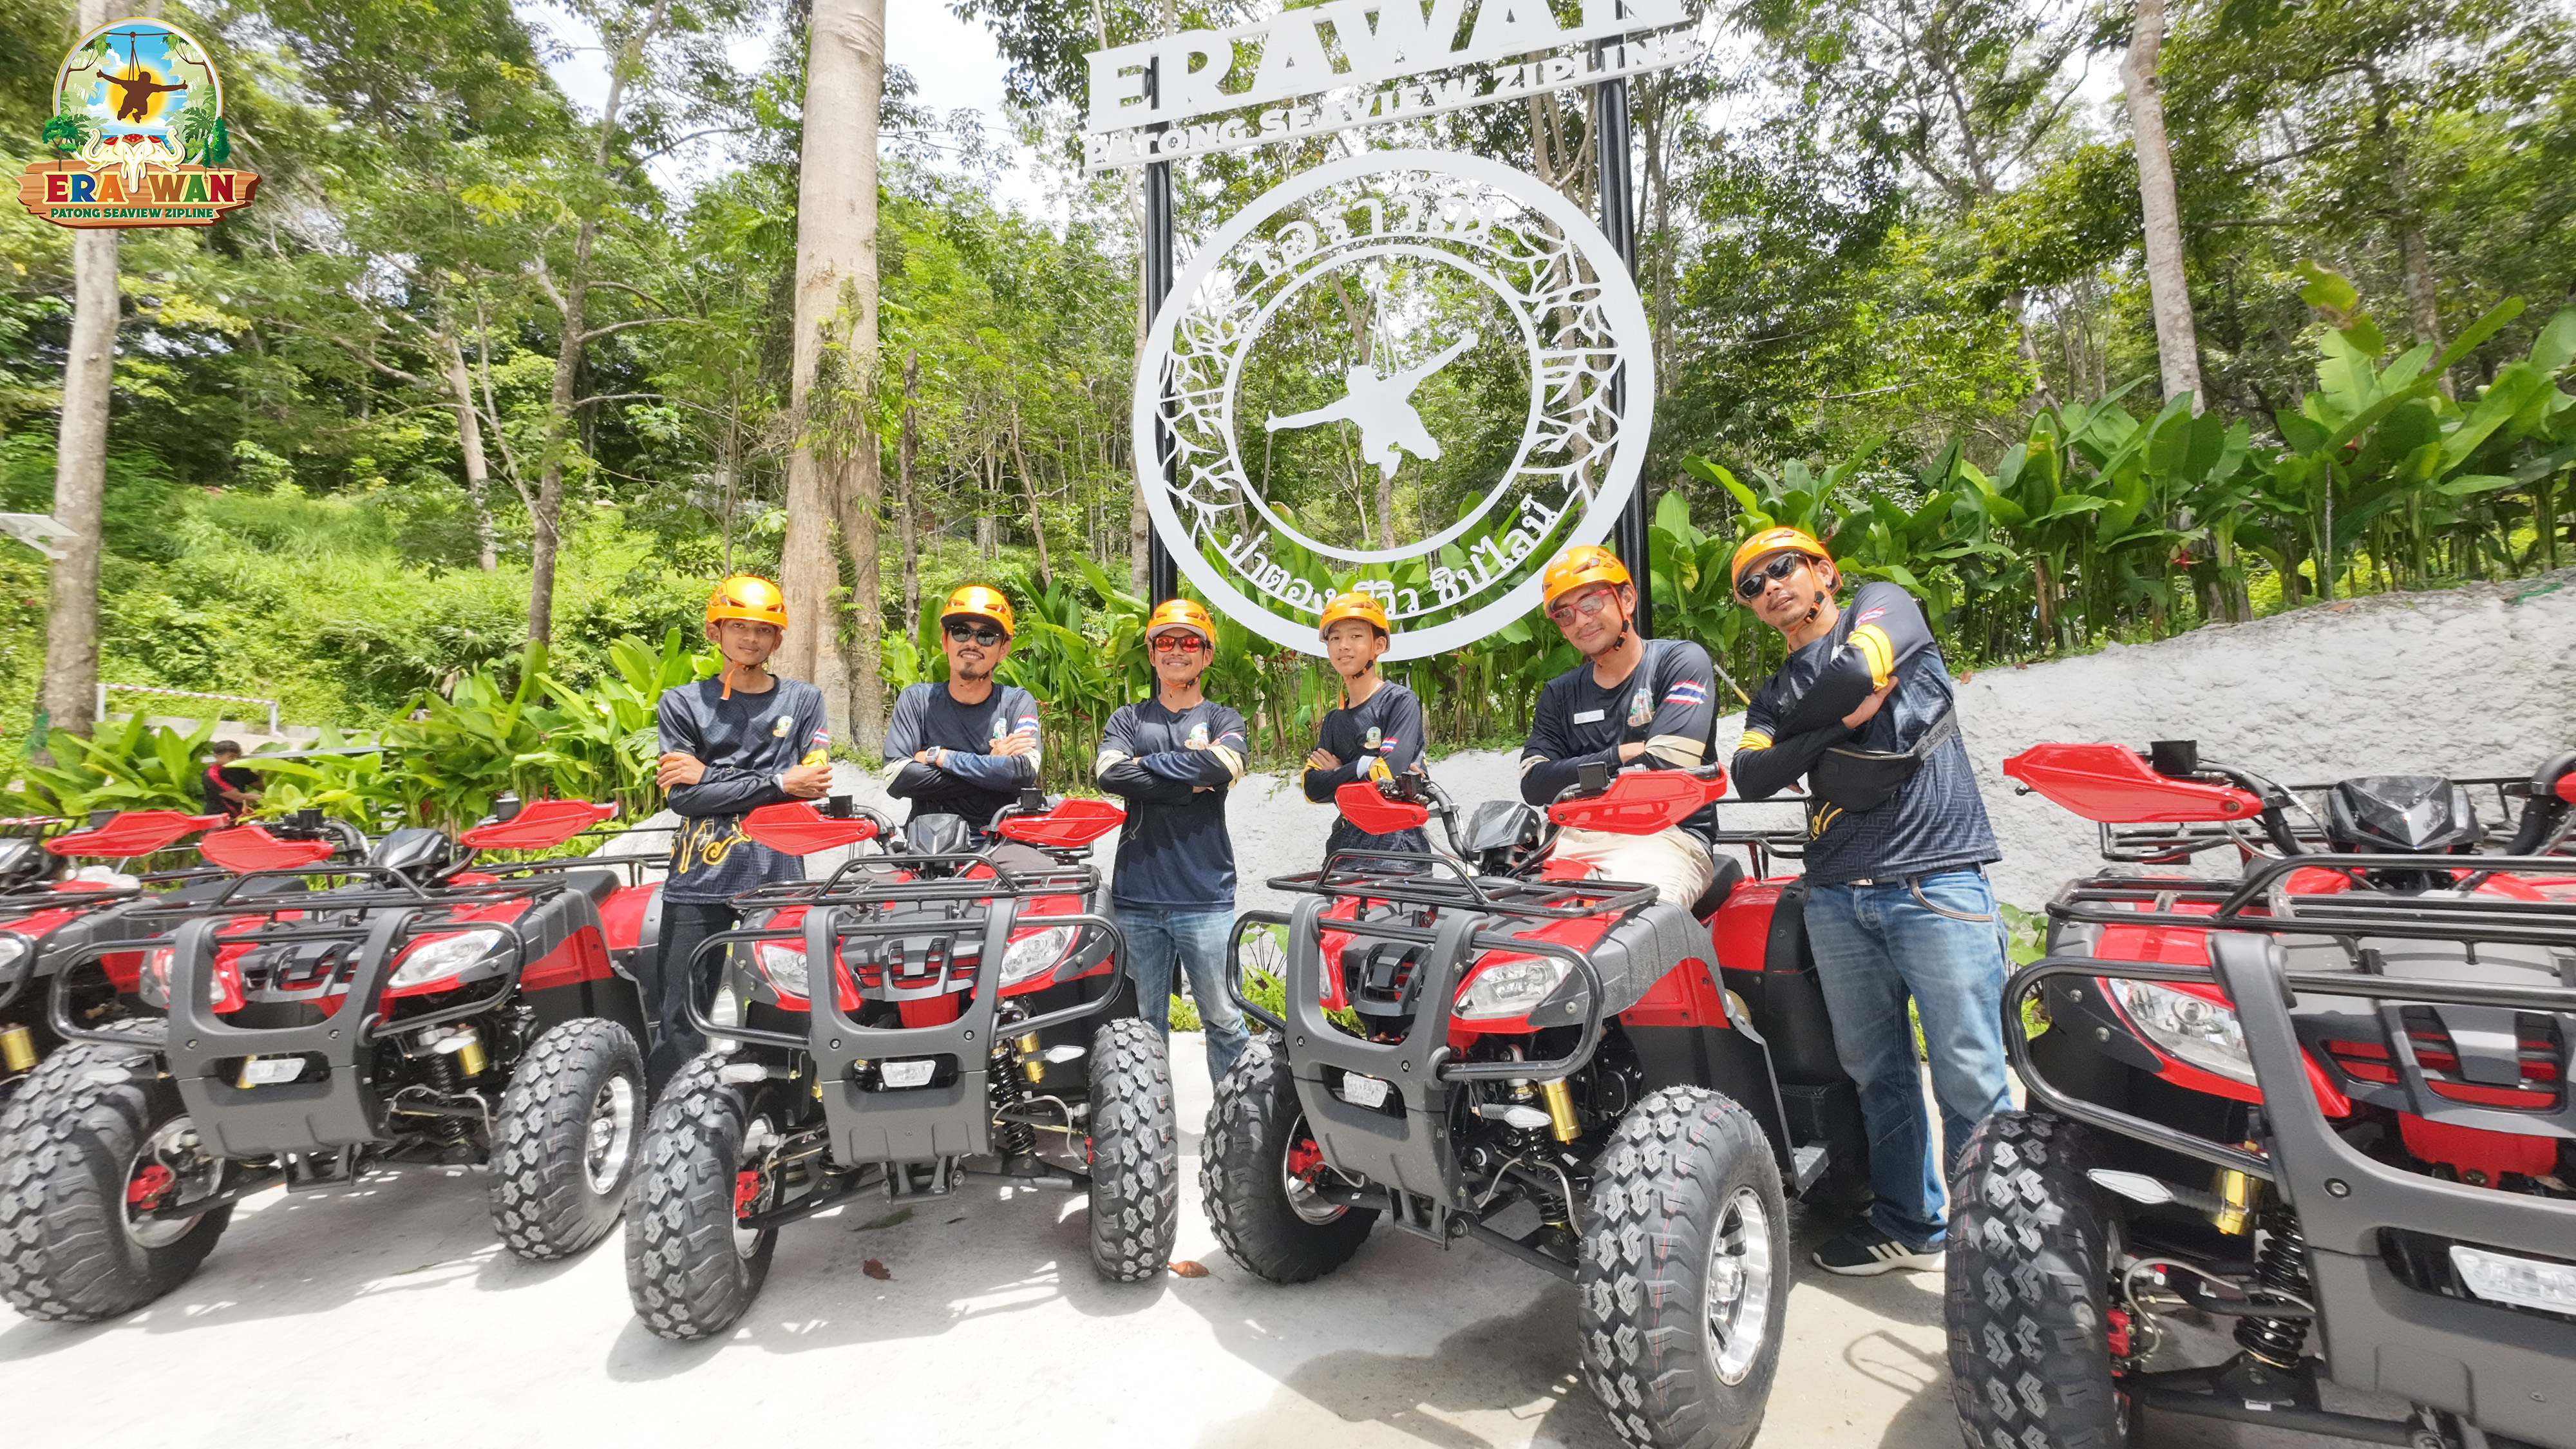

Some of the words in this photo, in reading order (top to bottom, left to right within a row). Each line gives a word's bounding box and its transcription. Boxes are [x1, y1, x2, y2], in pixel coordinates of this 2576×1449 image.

[1084, 118, 1247, 171] PATONG
[1258, 73, 1481, 140] SEAVIEW
[1492, 30, 1695, 94] ZIPLINE
